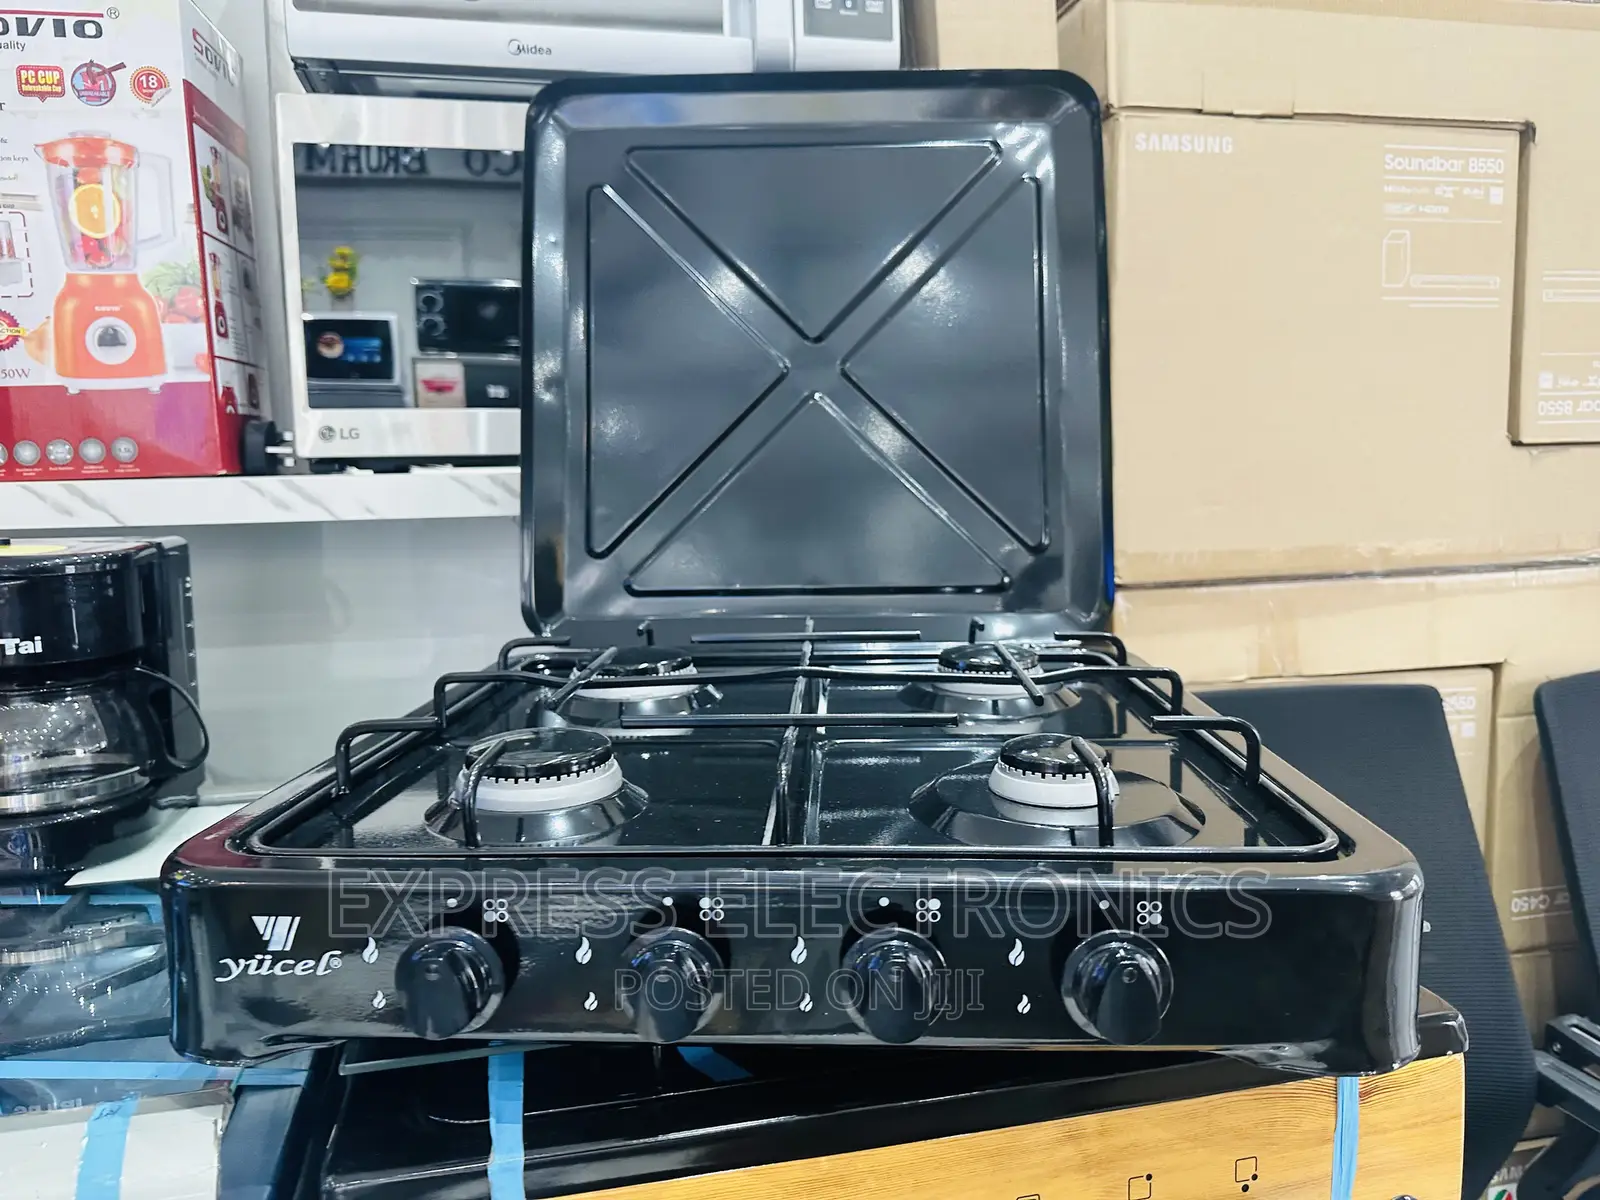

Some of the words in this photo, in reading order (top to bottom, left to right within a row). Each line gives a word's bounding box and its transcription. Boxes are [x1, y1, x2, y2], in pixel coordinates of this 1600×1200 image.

[510, 40, 552, 56] Midea
[21, 70, 35, 84] PC
[37, 70, 60, 86] CUP
[140, 75, 158, 88] 18
[1135, 132, 1233, 154] SAMSUNG
[13, 155, 29, 163] keys
[1384, 154, 1465, 172] Soundbar
[340, 428, 360, 440] LG
